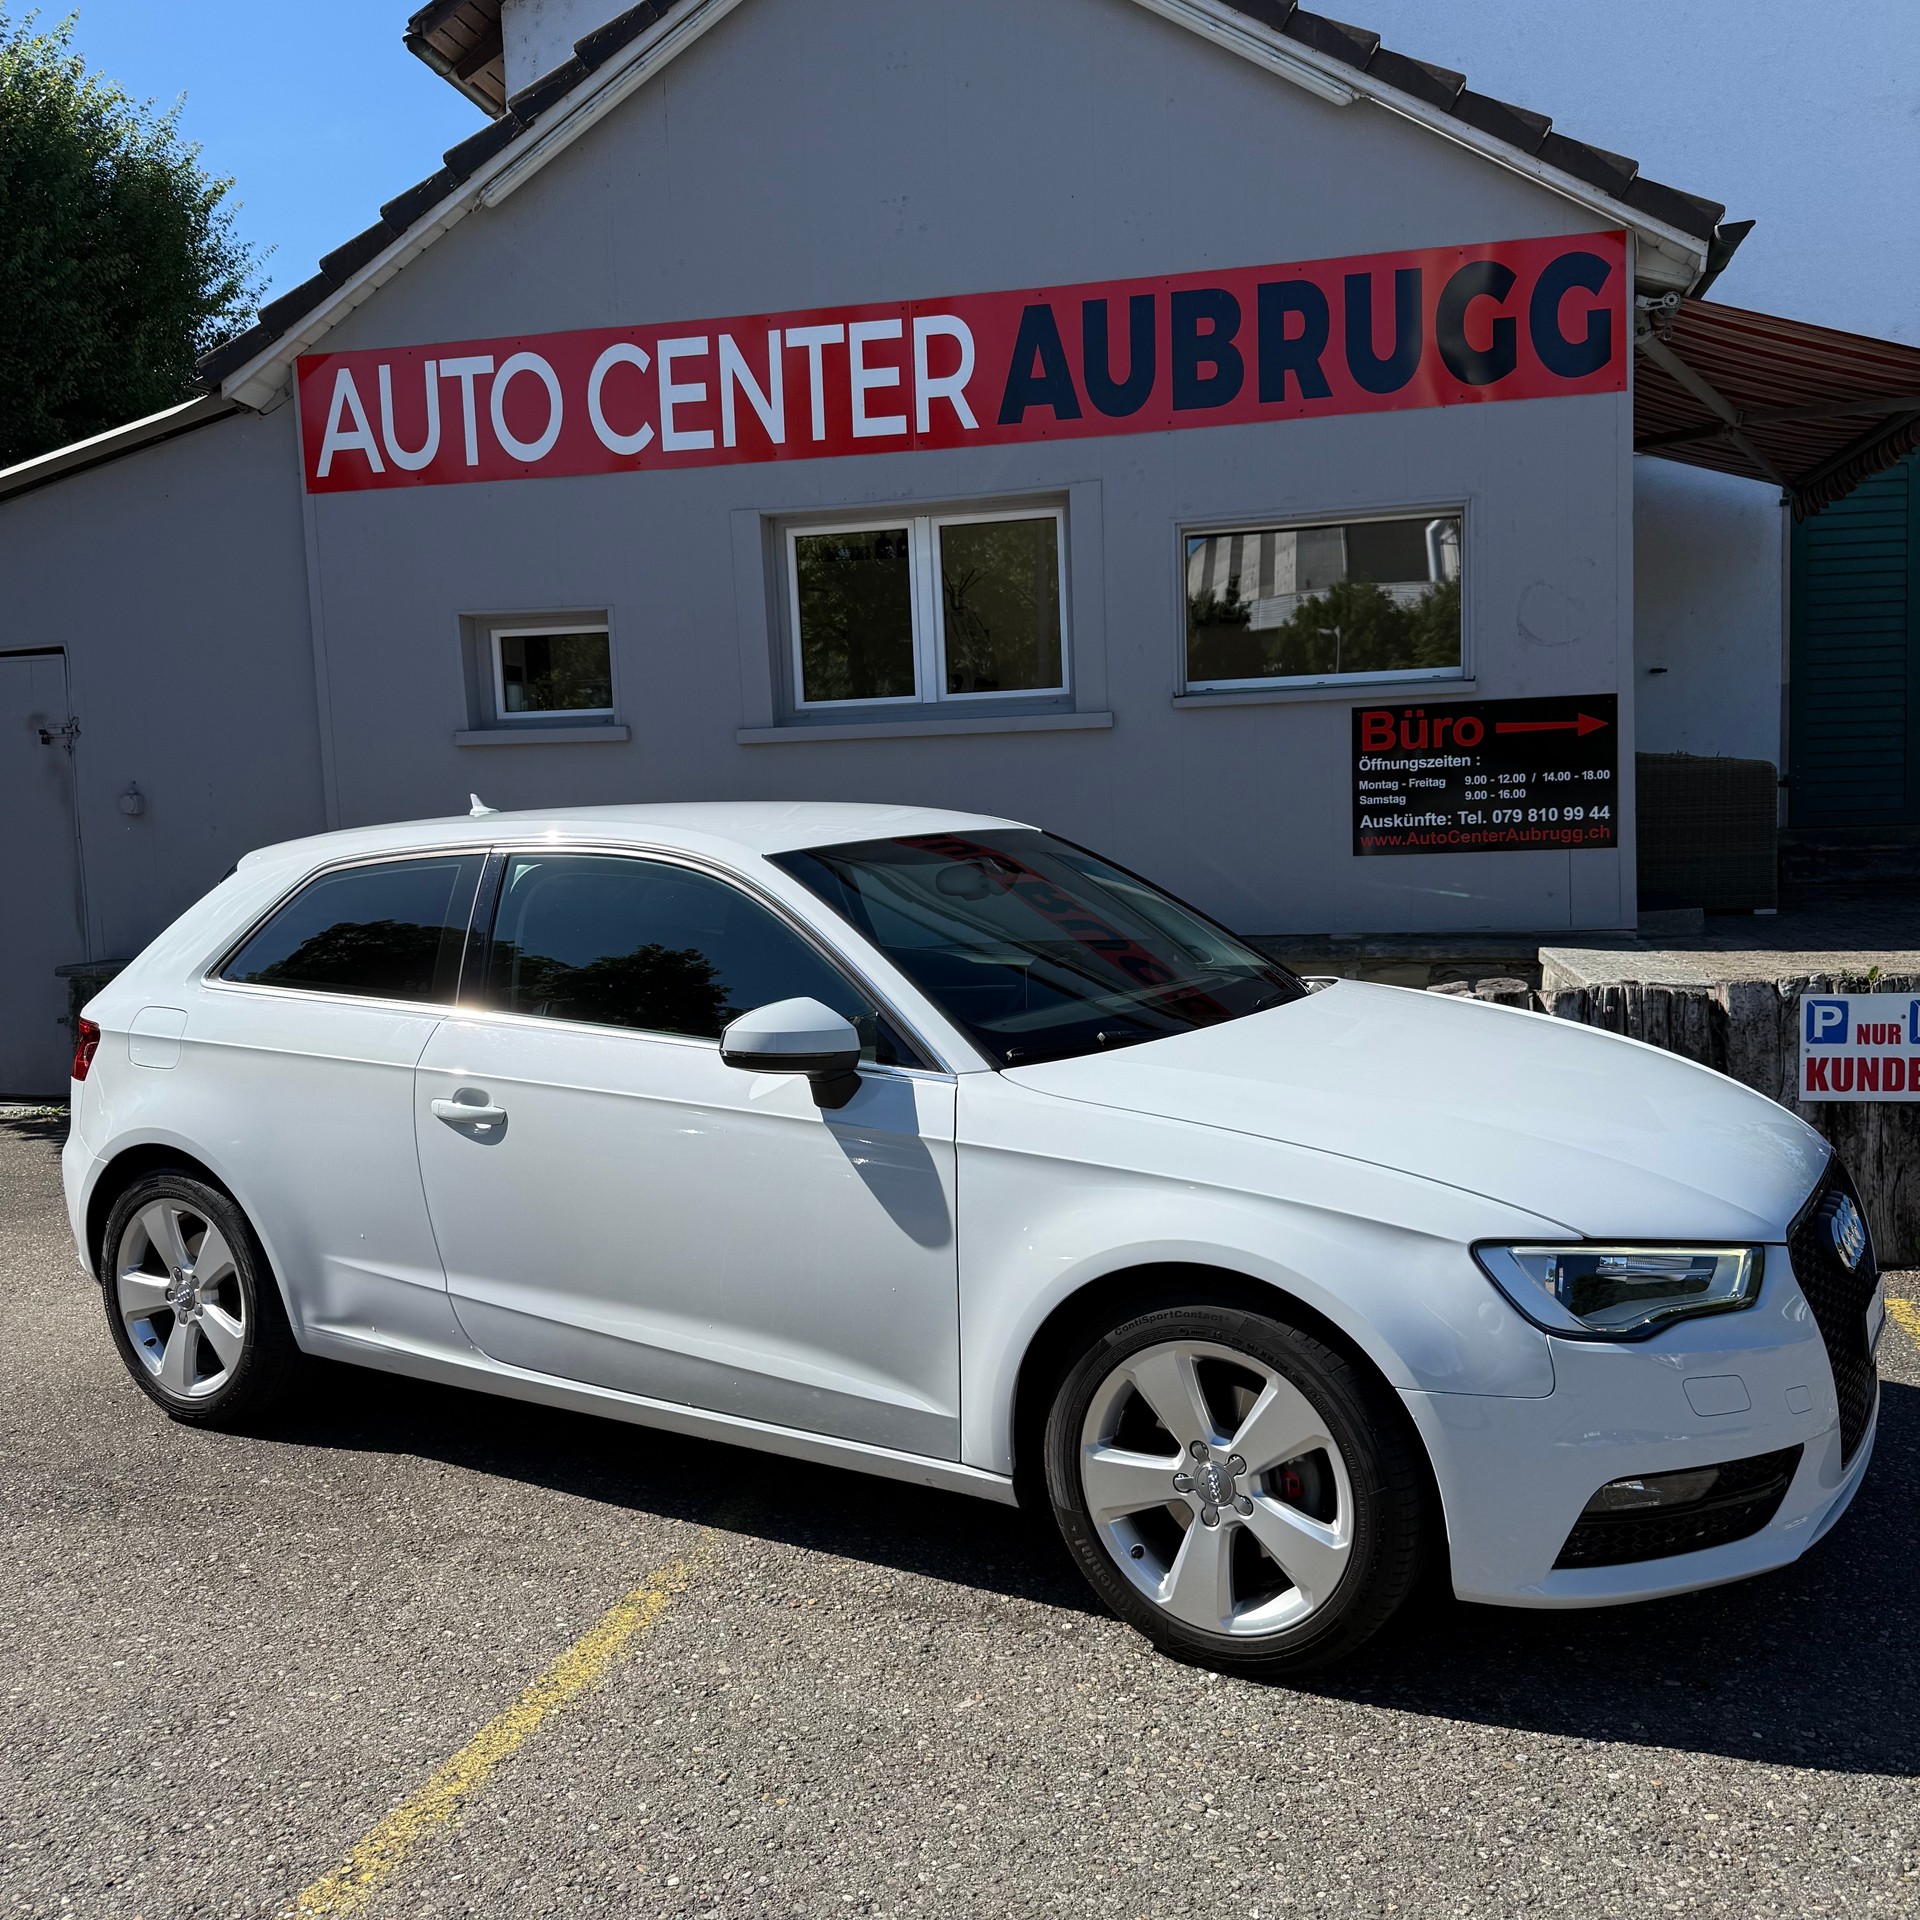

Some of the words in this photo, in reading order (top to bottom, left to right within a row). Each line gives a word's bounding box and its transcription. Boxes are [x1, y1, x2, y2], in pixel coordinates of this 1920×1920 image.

[316, 351, 563, 478] AUTO
[587, 314, 979, 455] CENTER
[997, 251, 1613, 425] AUBRUGG
[1362, 709, 1484, 752] Büro
[1359, 755, 1471, 772] Öffnungszeiten
[1359, 779, 1399, 791] Montag
[1408, 777, 1446, 788] Freitag
[1464, 775, 1488, 785] 9.00
[1497, 773, 1526, 784] 12.00
[1542, 771, 1571, 782] 14.00
[1581, 770, 1611, 780] 18.00
[1359, 794, 1406, 806] Samstag
[1464, 790, 1488, 801] 9.00
[1497, 789, 1526, 800] 16.00
[1359, 812, 1452, 829] Auskünfte:
[1457, 810, 1487, 825] Tel.
[1492, 808, 1523, 823] 079
[1527, 807, 1559, 822] 810
[1563, 806, 1584, 821] 99
[1588, 805, 1611, 820] 44
[1360, 824, 1611, 848] www.AutoCenterAubrugg.ch
[1814, 1005, 1843, 1038] P
[1856, 1023, 1902, 1045] NUR
[1114, 1310, 1223, 1336] ContiSportContact
